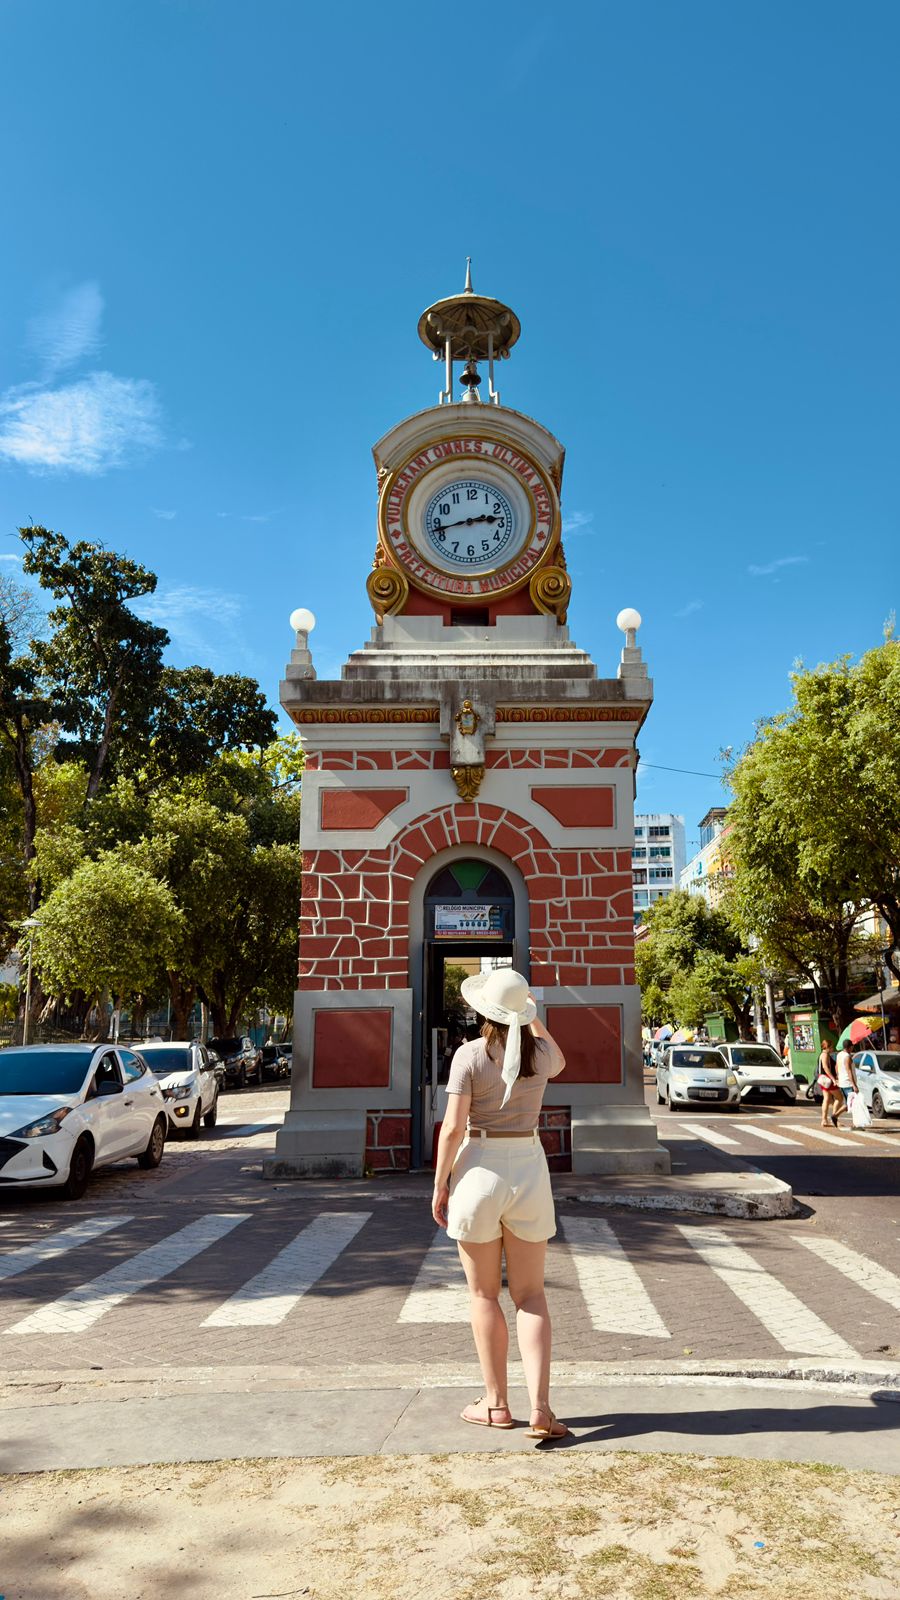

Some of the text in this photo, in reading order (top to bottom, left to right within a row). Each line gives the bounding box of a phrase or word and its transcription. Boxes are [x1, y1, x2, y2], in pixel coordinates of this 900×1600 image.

[388, 451, 432, 524] VULNERANT
[492, 443, 536, 482] ULTIMA
[532, 482, 551, 525] NECAT
[452, 493, 460, 504] 11
[467, 489, 478, 500] 12
[485, 493, 489, 504] 1
[439, 503, 450, 515] 10
[493, 503, 501, 514] 2
[433, 518, 441, 529] 9
[497, 517, 505, 528] 3
[439, 530, 446, 541] 8
[493, 529, 500, 541] 4
[452, 542, 460, 553] 7
[467, 545, 475, 556] 6
[481, 540, 489, 551] 5
[395, 541, 543, 593] PREFEITURA MUNICIPAL
